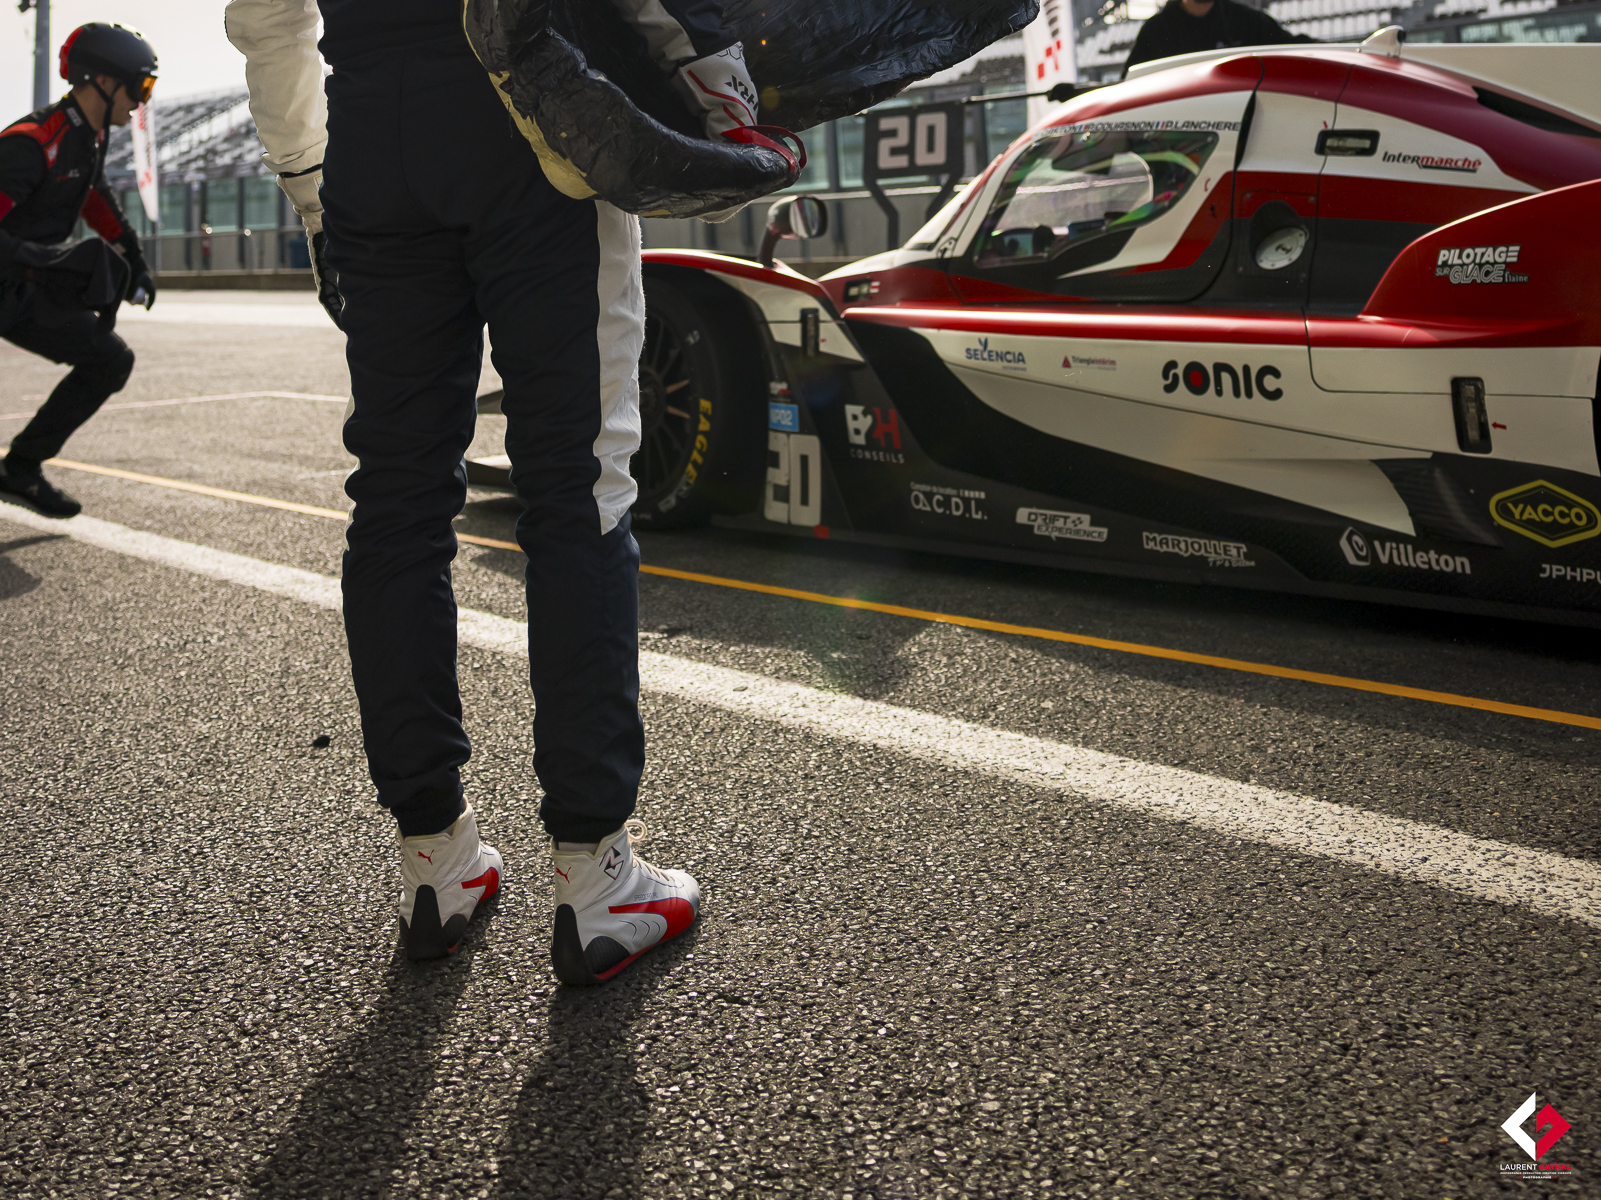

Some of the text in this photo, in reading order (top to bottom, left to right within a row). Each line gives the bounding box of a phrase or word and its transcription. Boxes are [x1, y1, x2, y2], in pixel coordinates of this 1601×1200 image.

[877, 111, 948, 170] 20
[1437, 246, 1520, 266] PILOTAGE
[1435, 267, 1450, 277] SUR
[1449, 263, 1505, 284] GLACE
[965, 347, 1026, 365] SELENCIA
[685, 398, 712, 483] EAGLE
[850, 449, 905, 464] CONSEILS
[764, 431, 821, 527] 20
[1027, 511, 1070, 526] DRIFT
[1507, 503, 1588, 526] YACCO
[1036, 524, 1105, 541] EXPERIENCE
[1143, 532, 1247, 559] MARJOLLET
[1373, 540, 1471, 574] Villeton
